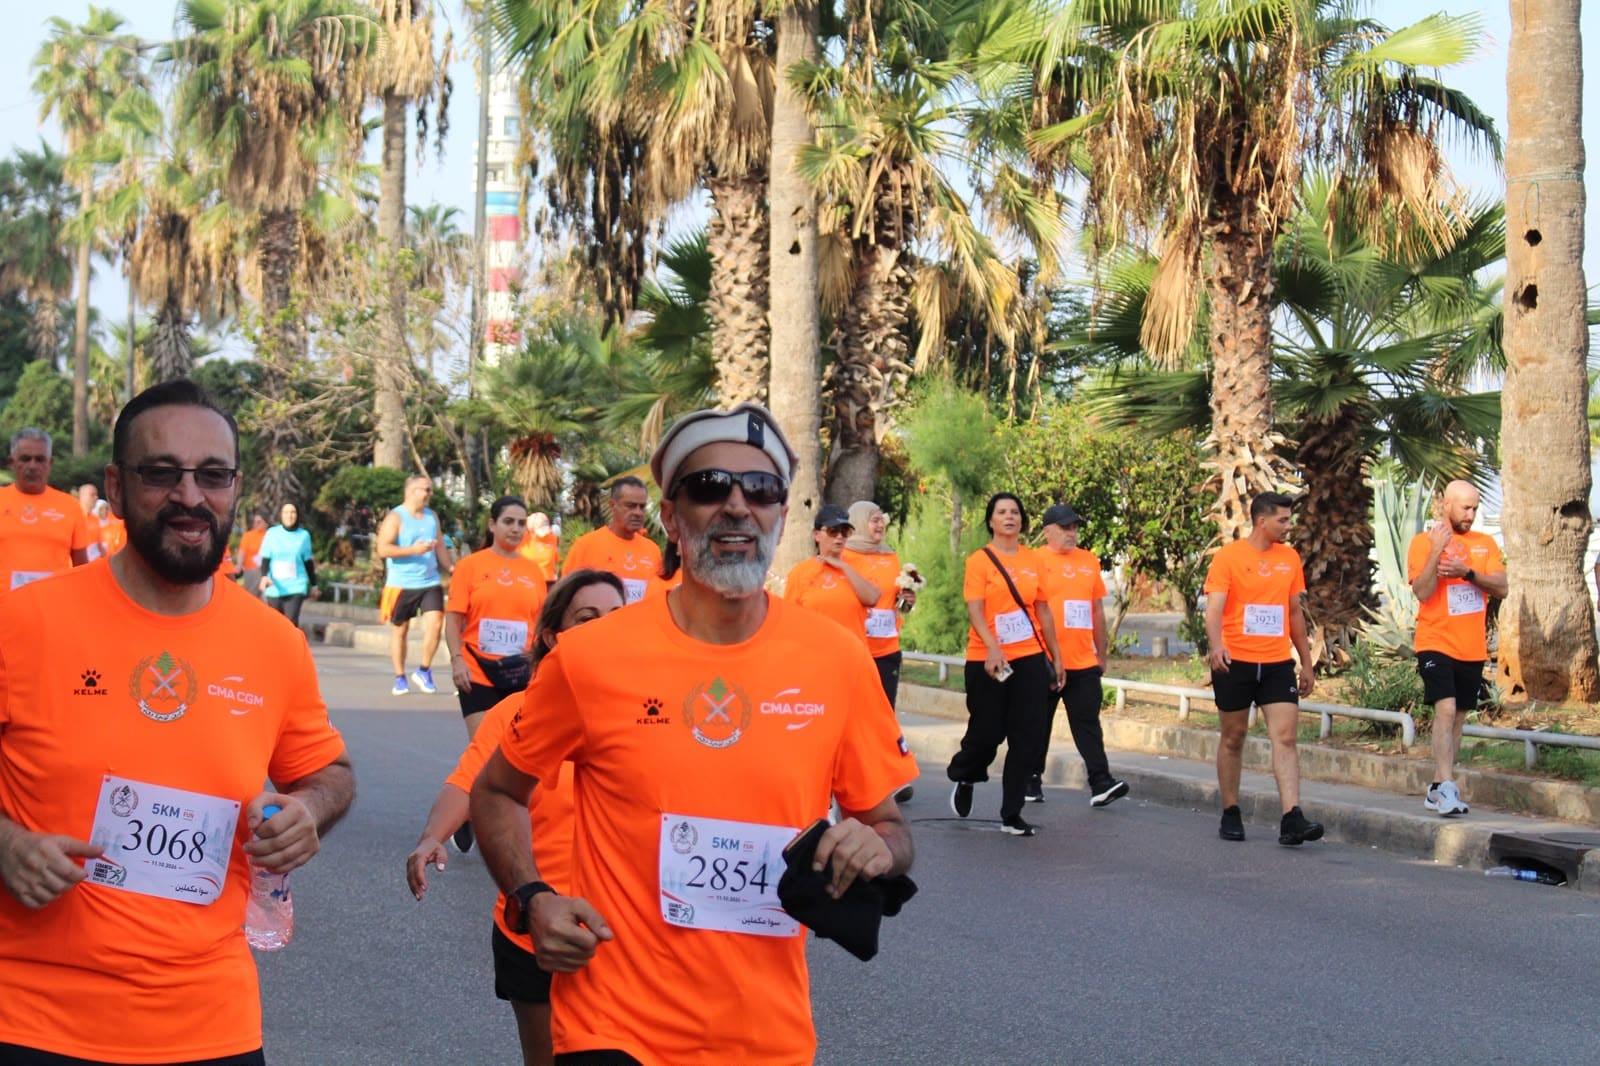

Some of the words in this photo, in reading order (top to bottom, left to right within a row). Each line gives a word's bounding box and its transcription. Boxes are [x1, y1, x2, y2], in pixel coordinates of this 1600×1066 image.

[488, 630, 518, 644] 2310
[207, 684, 235, 699] CMA
[236, 690, 264, 706] CGM
[760, 702, 793, 715] CMA
[794, 702, 825, 715] CGM
[151, 803, 181, 819] 5KM
[122, 819, 207, 864] 3068
[711, 836, 740, 851] 5KM
[686, 855, 769, 895] 2854
